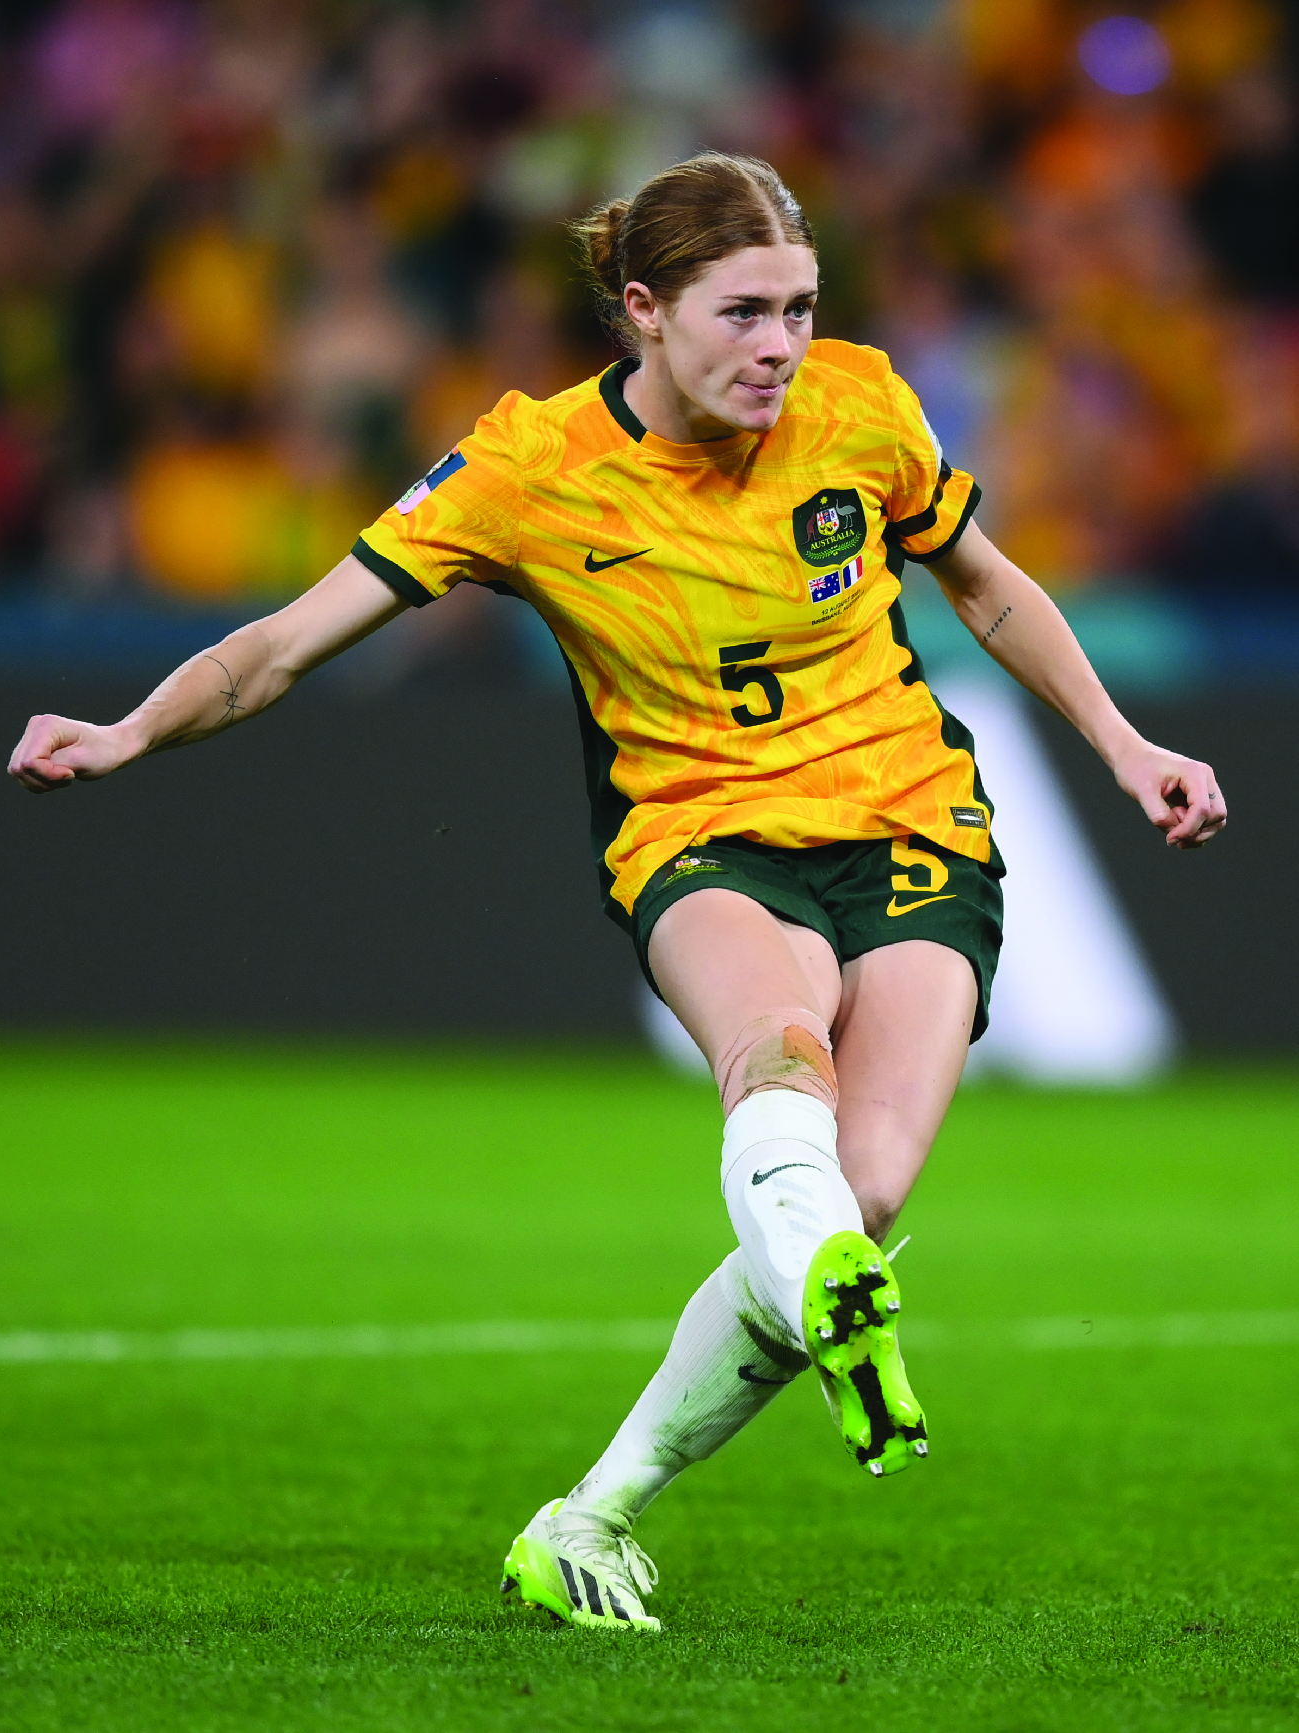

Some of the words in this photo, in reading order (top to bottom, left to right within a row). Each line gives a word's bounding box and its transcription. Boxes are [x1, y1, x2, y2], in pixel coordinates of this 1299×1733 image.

[810, 529, 855, 551] AUSTRALIA
[718, 640, 785, 728] 5
[890, 834, 949, 893] 5
